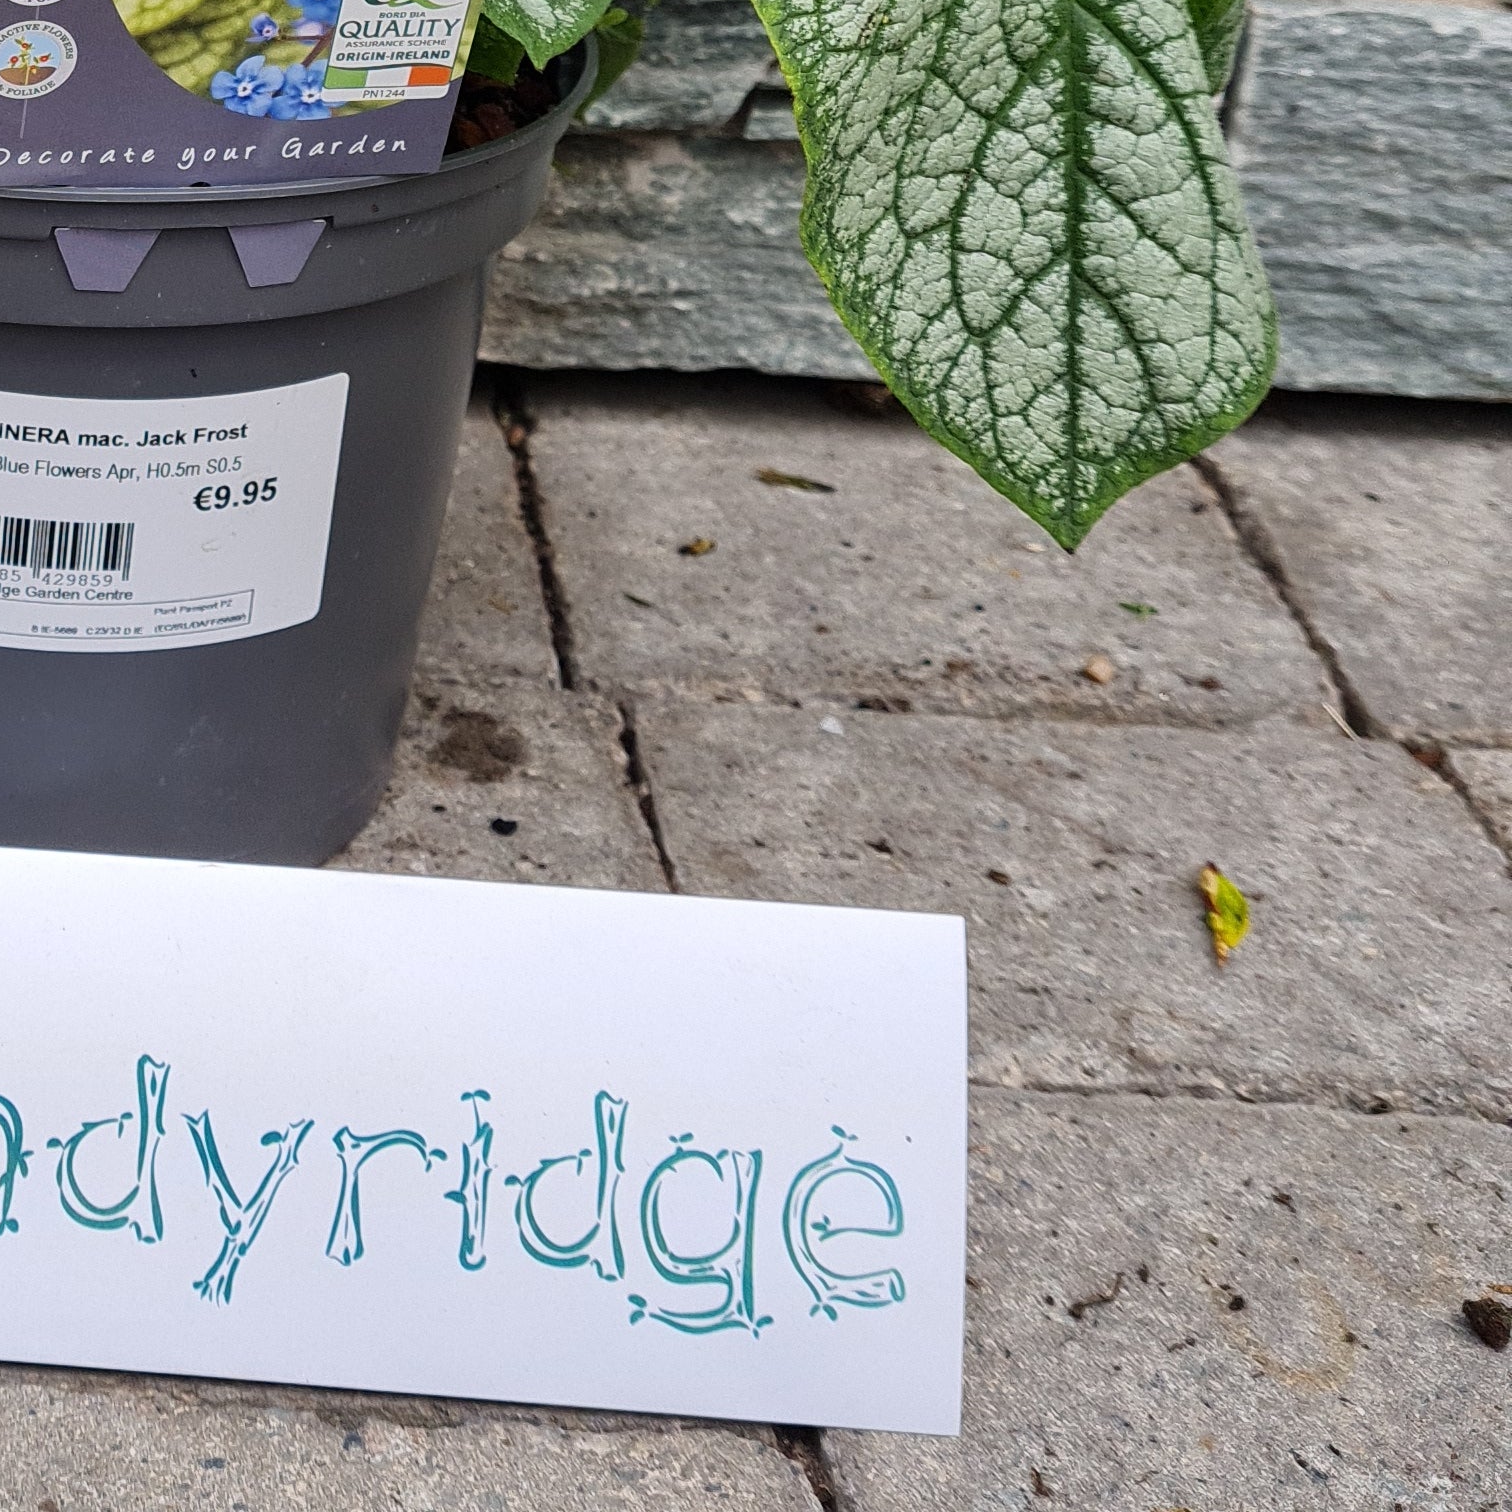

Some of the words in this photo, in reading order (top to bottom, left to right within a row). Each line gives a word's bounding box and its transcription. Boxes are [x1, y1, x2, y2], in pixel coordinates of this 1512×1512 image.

[379, 11, 407, 19] BORD
[339, 18, 461, 39] QUALITY
[42, 24, 74, 60] FLOWERS
[345, 39, 404, 48] ASSURANCE
[407, 38, 447, 47] SCHEME
[335, 49, 451, 62] ORIGIN-IRELAND
[6, 80, 56, 96] FOLIAGE
[362, 89, 406, 99] PN1244
[177, 142, 257, 170] your
[281, 134, 407, 160] Garden
[77, 432, 130, 447] mac.
[136, 429, 188, 447] Jack
[193, 423, 248, 444] Frost
[34, 459, 102, 479] Flowers
[106, 463, 140, 483] Apr,
[146, 462, 200, 479] H0.5m
[206, 455, 242, 475] S0.5
[193, 476, 278, 511] €9.95
[42, 572, 113, 587] 429859
[26, 586, 80, 600] Garden
[84, 588, 133, 601] Centre
